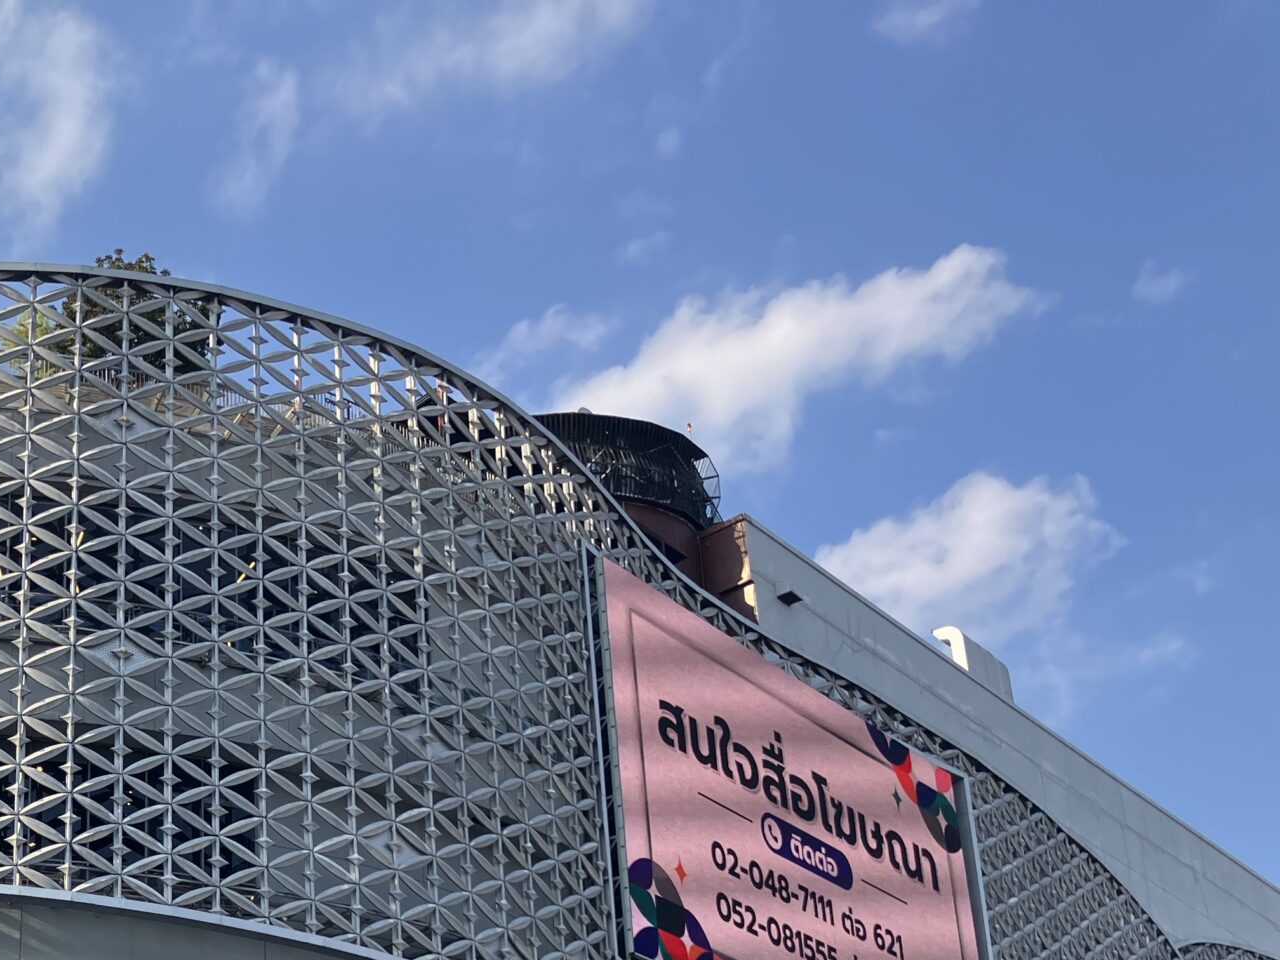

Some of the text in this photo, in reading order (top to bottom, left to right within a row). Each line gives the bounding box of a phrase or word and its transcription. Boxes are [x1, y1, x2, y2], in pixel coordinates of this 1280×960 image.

[657, 698, 940, 893] สนใจสื่อโฆษณา
[711, 840, 835, 926] 02-048-7111
[841, 907, 867, 941] ต่อ
[789, 834, 839, 878] ติดต่อ
